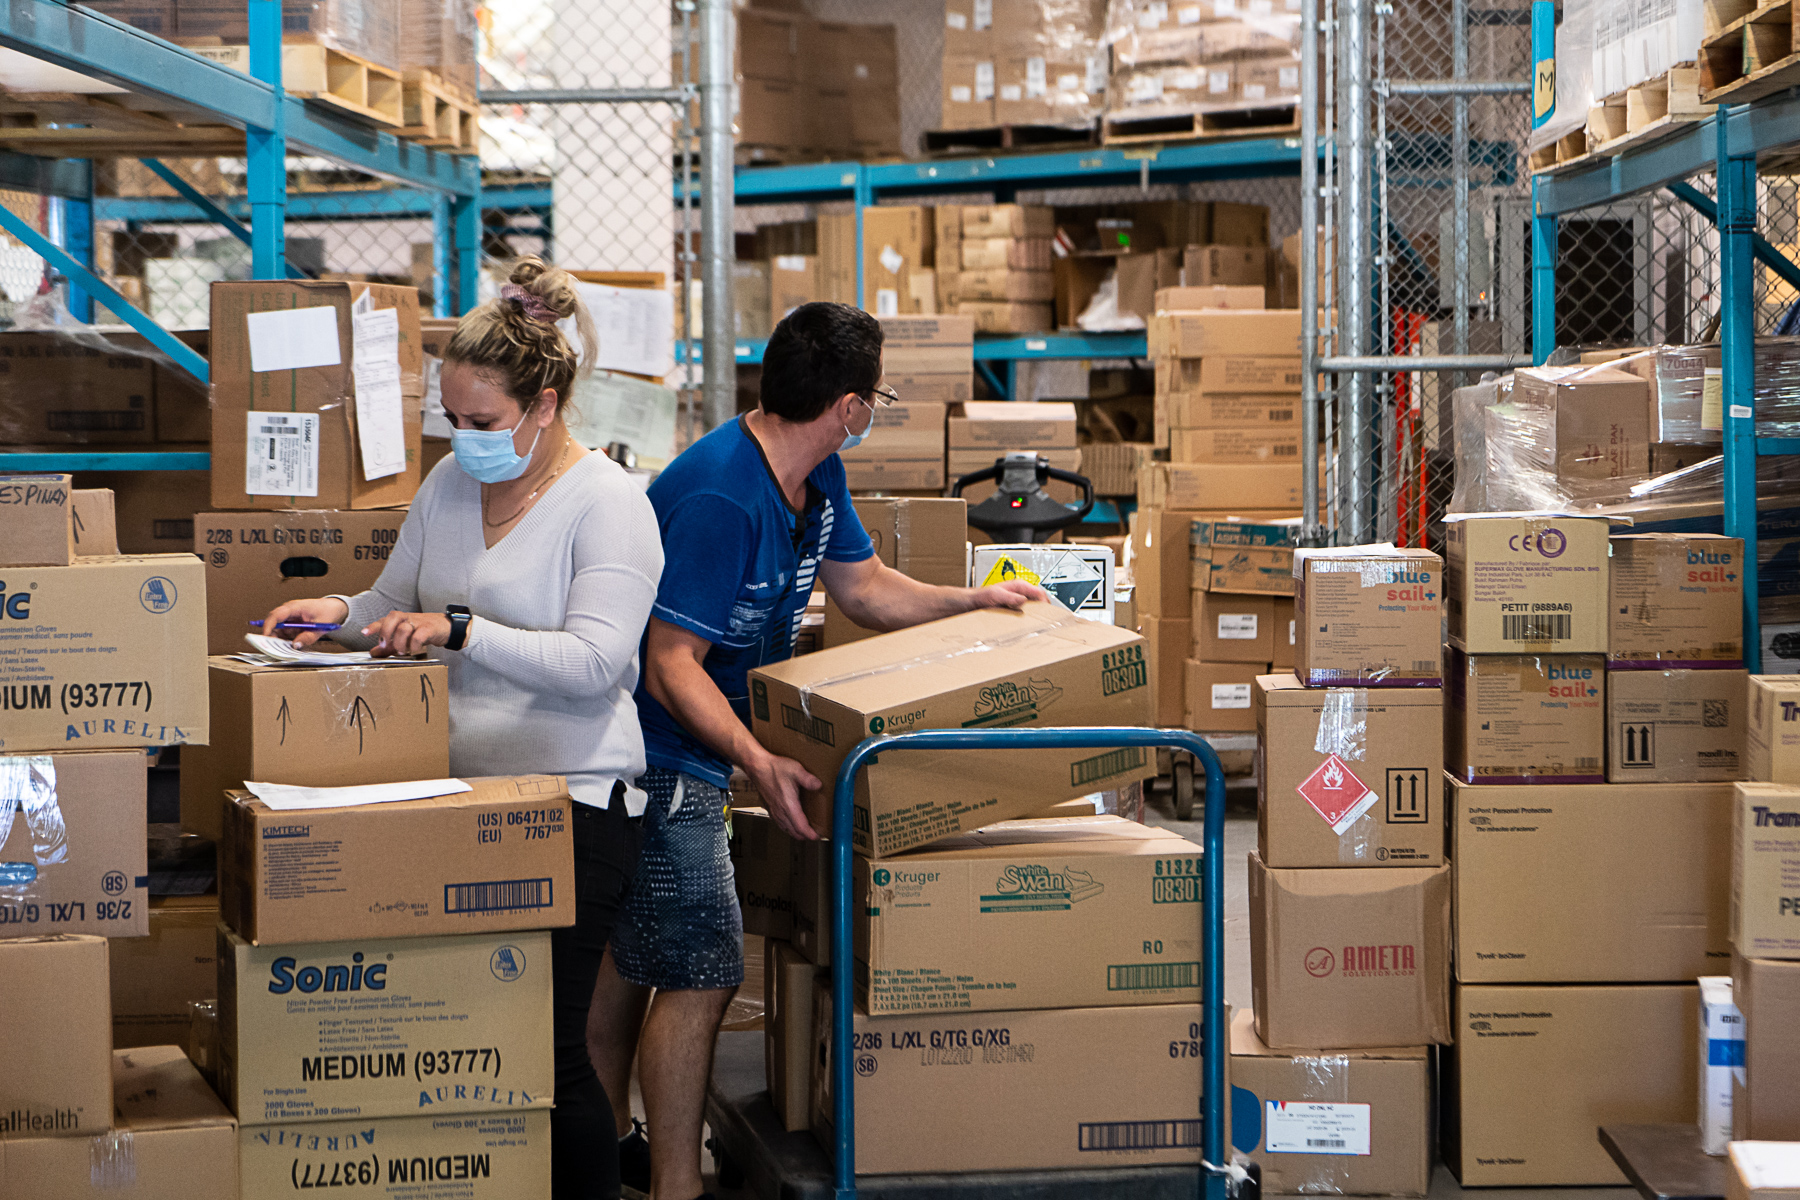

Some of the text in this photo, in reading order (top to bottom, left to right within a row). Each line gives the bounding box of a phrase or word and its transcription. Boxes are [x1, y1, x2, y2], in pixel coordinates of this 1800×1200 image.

[1540, 72, 1553, 92] M
[1665, 358, 1704, 369] 70044
[1610, 423, 1618, 442] PAK
[206, 529, 233, 545] 2/28
[240, 529, 269, 545] L/XL
[273, 529, 306, 544] G/TG
[309, 529, 343, 544] G/XG
[213, 552, 226, 564] SB
[1687, 549, 1731, 564] blue
[1069, 597, 1075, 605] 8
[1501, 603, 1529, 611] PETIT
[35, 625, 57, 633] Gloves
[70, 632, 93, 640] poudre
[1103, 661, 1146, 695] 08301
[1548, 664, 1592, 680] blue
[0, 681, 152, 715] IUM (93777)
[975, 687, 1030, 718] Swan
[887, 708, 927, 728] Kruger
[65, 718, 187, 742] AURELIA
[478, 809, 563, 828] (US) 06471 02
[1330, 812, 1336, 820] 3
[263, 825, 309, 835] KIMTECH
[478, 829, 502, 845] (EU)
[105, 876, 123, 891] SB
[895, 871, 940, 886] Kruger
[997, 866, 1064, 894] Swan
[45, 901, 85, 922] L/XL
[96, 899, 132, 921] 2/36
[1343, 945, 1416, 970] AMETA
[268, 952, 388, 995] Sonic
[891, 1031, 926, 1050] L/XL
[930, 1030, 968, 1049] G/TG
[972, 1028, 1010, 1048] G/XG
[302, 1047, 501, 1082] MEDIUM (93777)
[859, 1058, 874, 1073] SB
[286, 1100, 314, 1109] Gloves
[418, 1085, 536, 1108] AURELIA
[254, 1128, 375, 1151] AURELIA
[291, 1153, 490, 1189] MEDIUM (93777)
